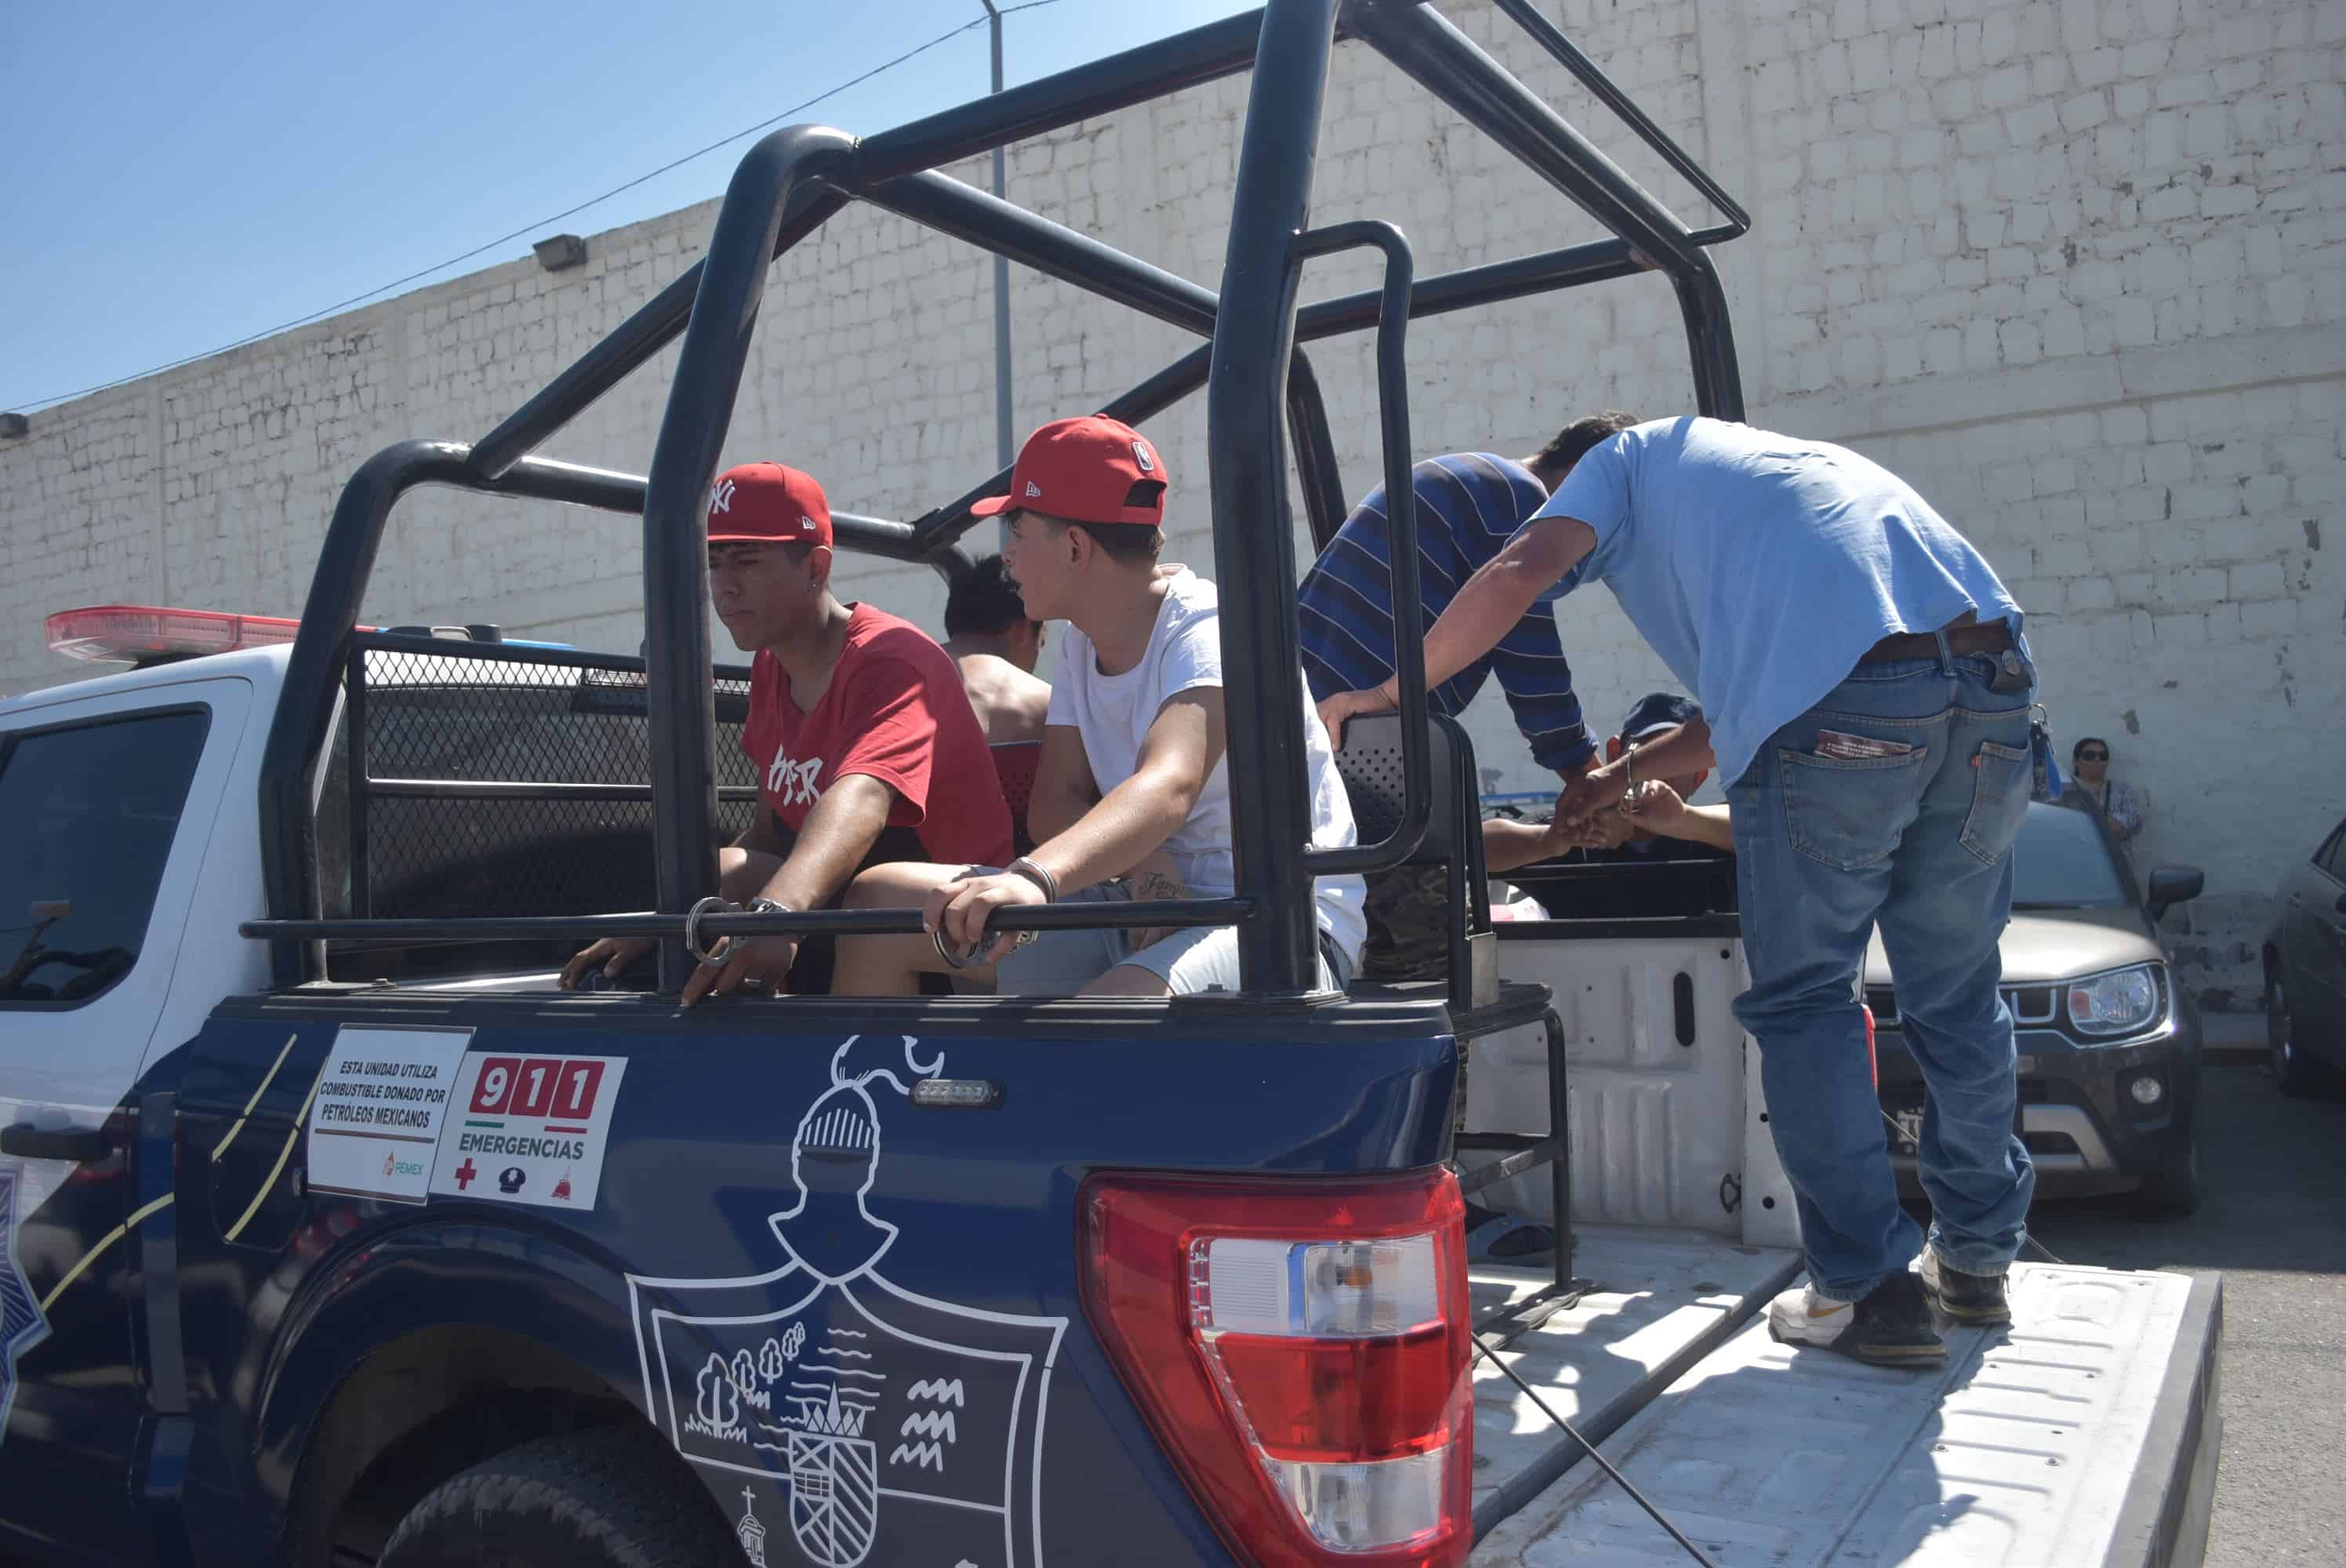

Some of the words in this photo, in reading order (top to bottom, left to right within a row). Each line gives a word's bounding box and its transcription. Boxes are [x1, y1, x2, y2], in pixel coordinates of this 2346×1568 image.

[340, 1061, 364, 1075] ESTA
[365, 1062, 400, 1076] UNIDAD
[401, 1064, 438, 1080] UTILIZA
[320, 1082, 383, 1098] COMBUSTIBLE
[384, 1086, 424, 1102] DONADO
[425, 1089, 446, 1104] POR
[479, 1066, 590, 1110] 911
[375, 1106, 430, 1128] MEXICANOS
[459, 1132, 584, 1160] EMERGENCIAS
